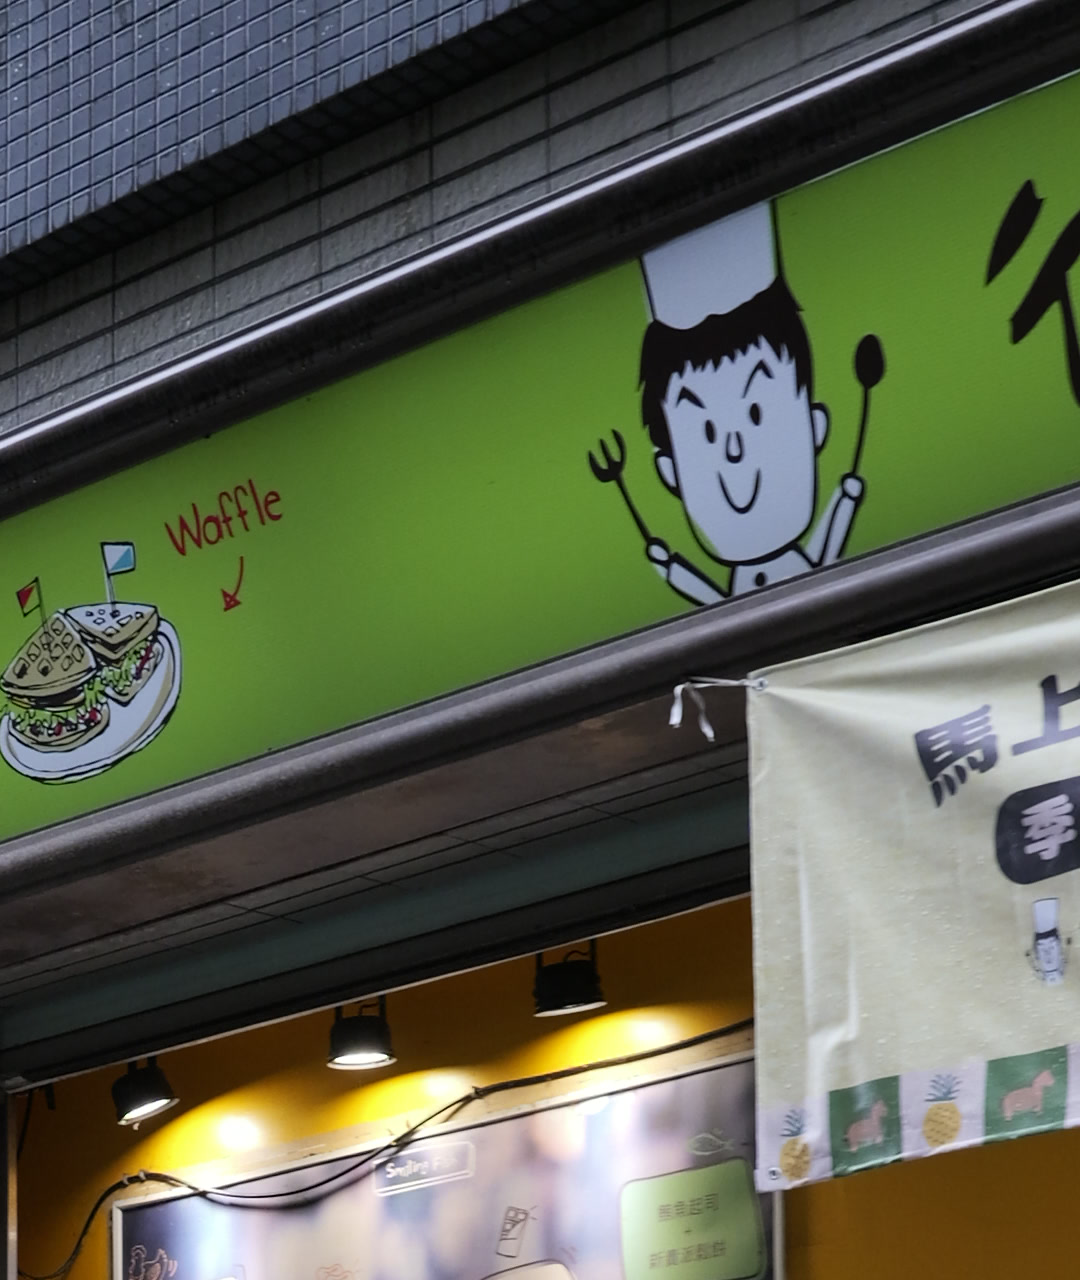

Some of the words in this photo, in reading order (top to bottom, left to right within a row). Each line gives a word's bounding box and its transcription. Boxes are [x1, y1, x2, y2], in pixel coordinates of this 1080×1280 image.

[164, 479, 284, 556] Waffle
[914, 675, 1080, 808] 馬上
[1021, 794, 1077, 861] 季
